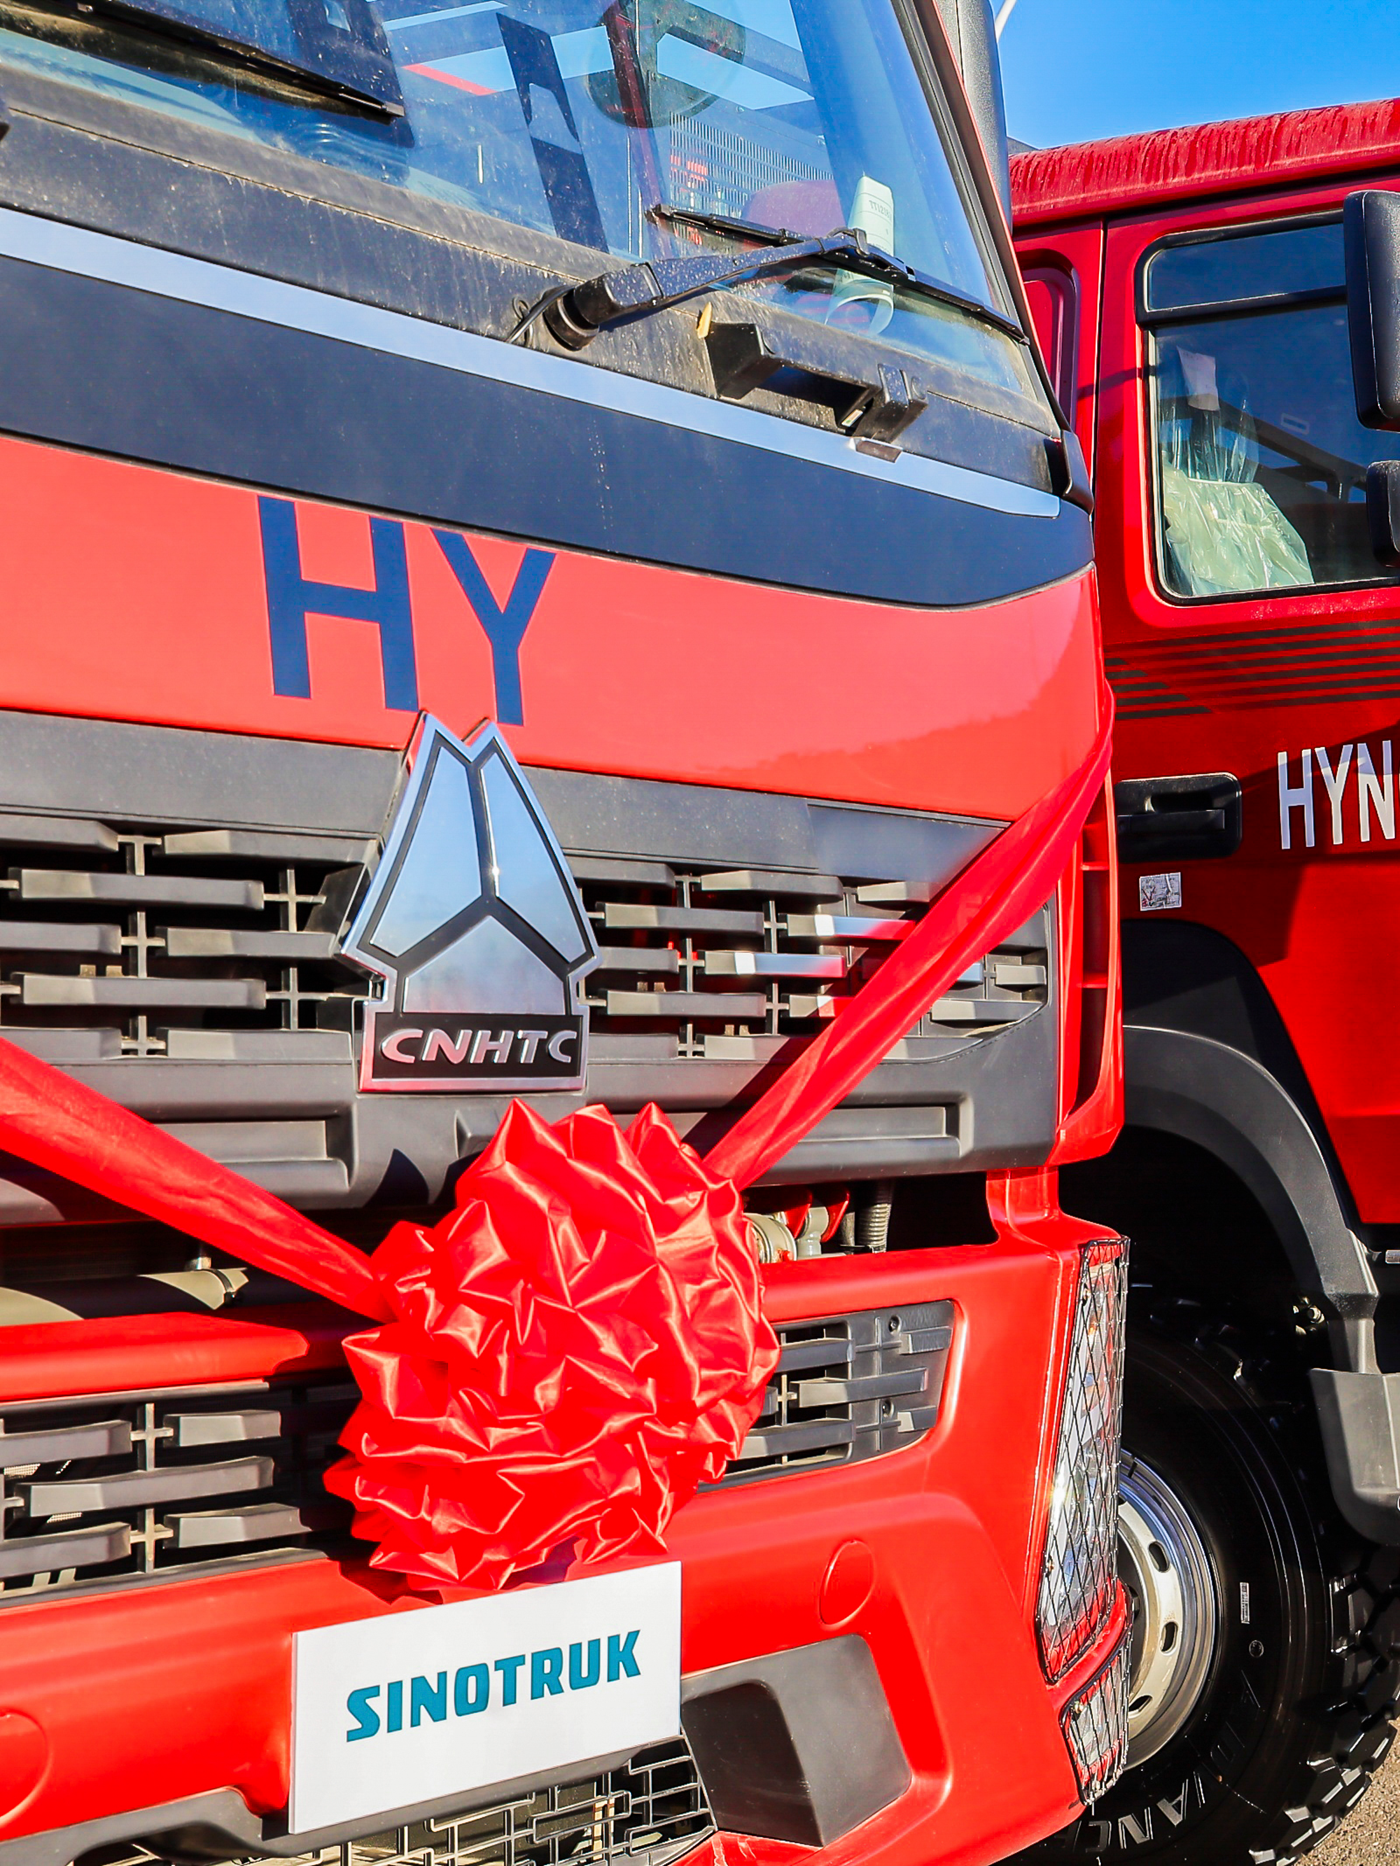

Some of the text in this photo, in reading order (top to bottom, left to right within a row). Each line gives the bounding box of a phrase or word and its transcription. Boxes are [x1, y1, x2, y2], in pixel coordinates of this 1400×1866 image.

[257, 495, 556, 726] HY
[380, 1027, 579, 1064] CNHTC
[346, 1629, 642, 1743] SINOTRUK
